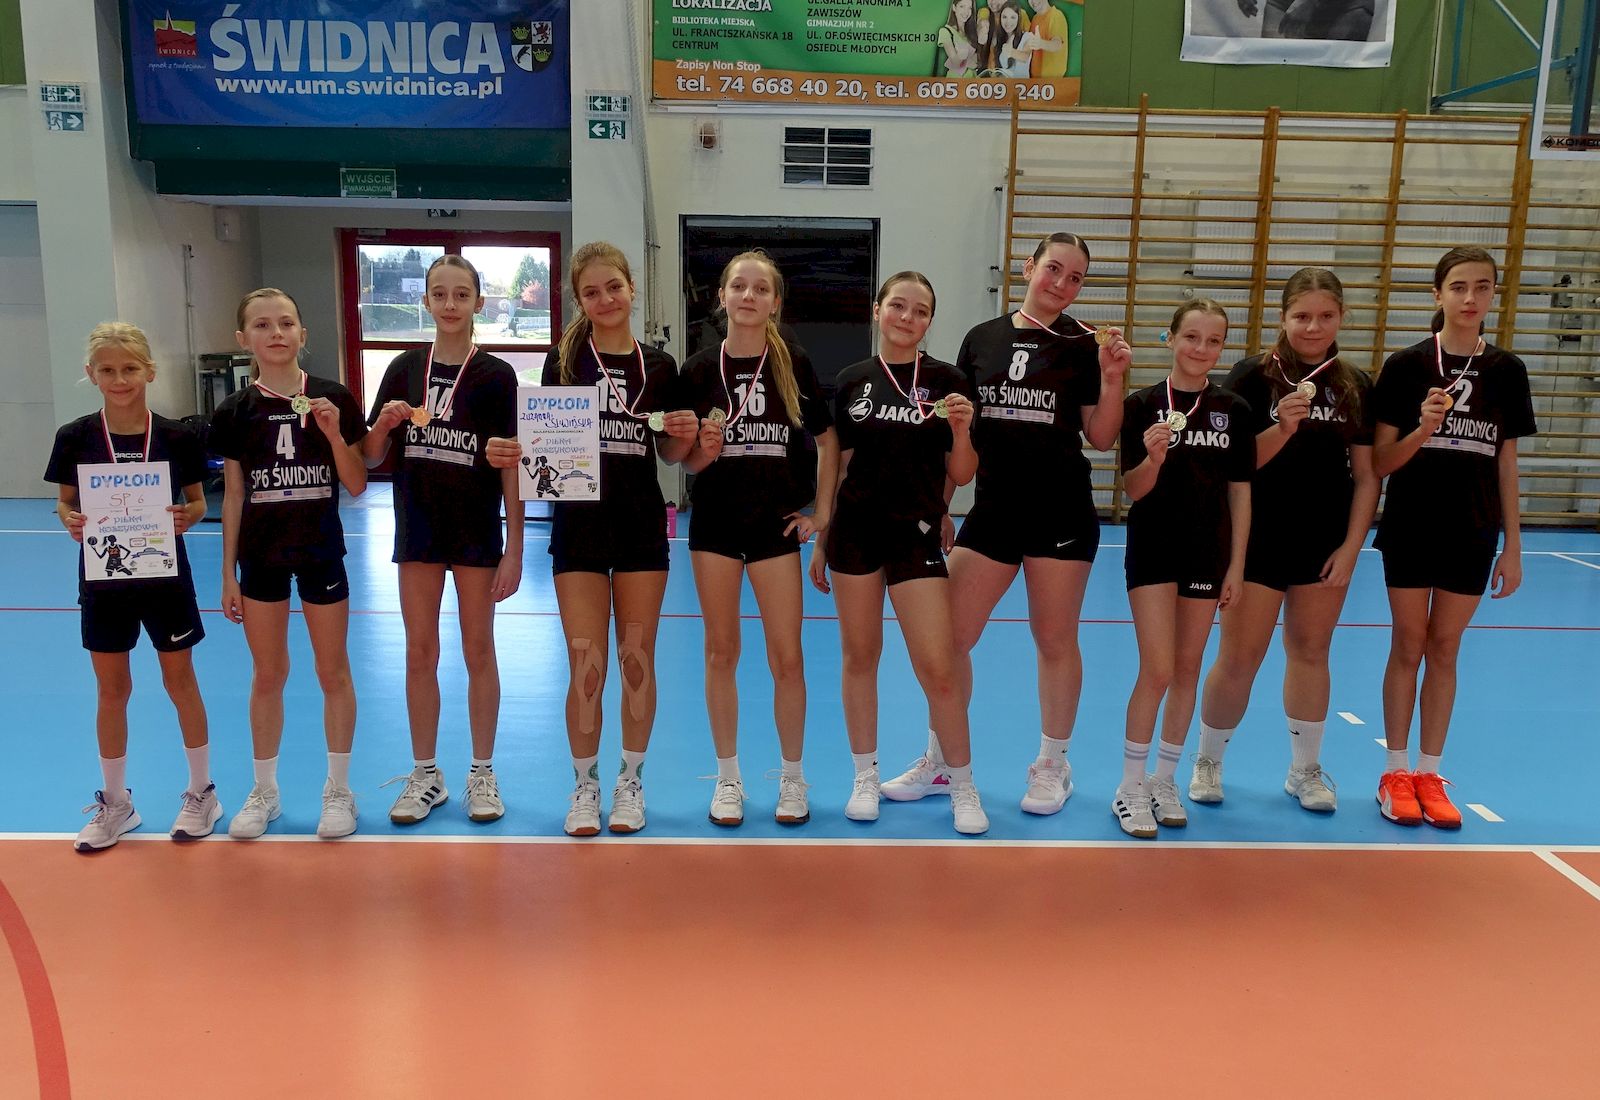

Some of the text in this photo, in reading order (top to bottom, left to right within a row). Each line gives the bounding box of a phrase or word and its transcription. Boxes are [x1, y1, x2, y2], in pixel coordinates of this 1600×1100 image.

[672, 0, 773, 11] LOKALIZACJA
[807, 7, 862, 18] ZAWISZÓW
[672, 16, 755, 27] BIBLIOTEKA MIEJSKA
[806, 19, 875, 29] GIMNAZJUM NR 2
[209, 4, 506, 74] ŚWIDNICA
[672, 28, 793, 41] UL. FRANCISZKAŃSKA 18
[807, 31, 822, 40] UL.
[924, 34, 936, 42] 30
[672, 41, 719, 50] CENTRUM
[806, 43, 897, 54] OSIEDLE MŁODYCH
[676, 59, 761, 73] Zapisy Non Stop
[215, 75, 503, 99] www.um.swidnica.pl
[676, 75, 1055, 101] tel. 74 668 40 20, tel. 605 609 240
[1008, 350, 1030, 381] 8
[596, 377, 627, 414] 15
[734, 381, 766, 417] 16
[862, 382, 873, 397] 9
[978, 380, 1056, 410] SP6 ŚWIDNICA
[1453, 378, 1473, 412] 2
[428, 385, 454, 421] 14
[527, 397, 590, 411] DYPLOM
[875, 404, 925, 425] JAKO
[1216, 416, 1224, 427] 6
[600, 420, 646, 442] WIDNIC
[737, 418, 789, 443] ŚWIDNICA
[1445, 411, 1498, 442] ŚWIDNICA
[276, 424, 296, 460] 4
[1185, 430, 1230, 449] JAKO
[90, 473, 160, 489] DYPLOM
[250, 461, 332, 490] SP6 ŚWIDNICA
[1189, 582, 1212, 591] JAKO
